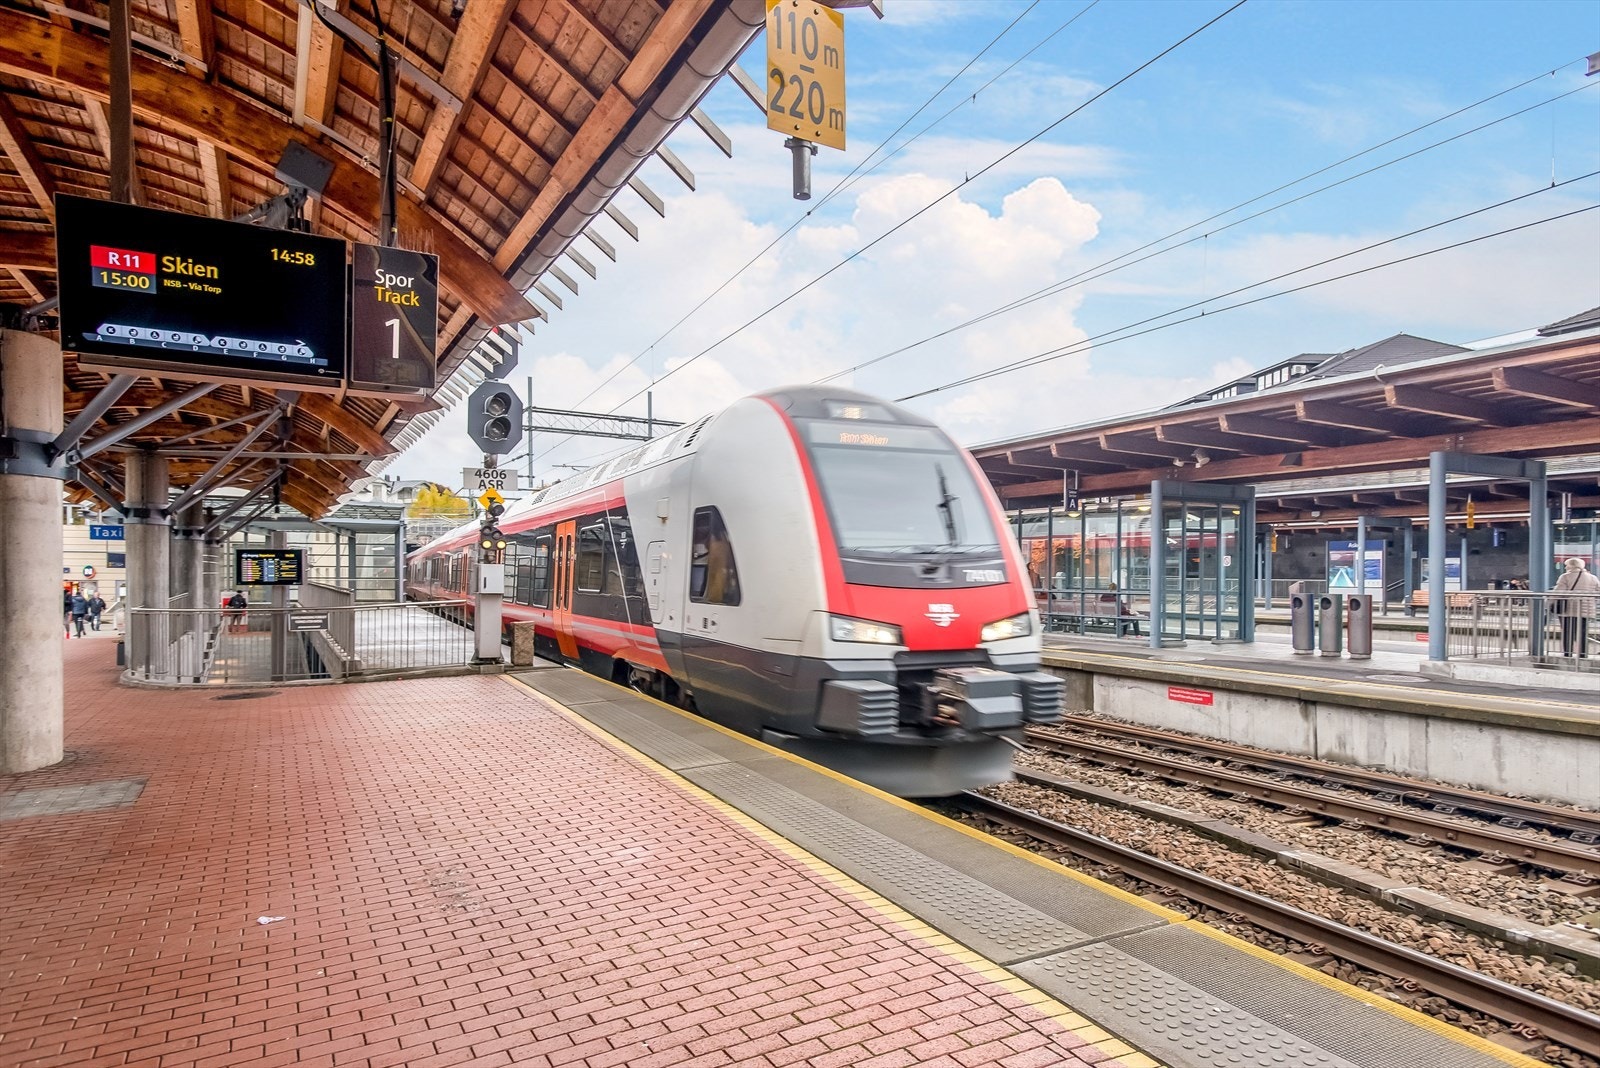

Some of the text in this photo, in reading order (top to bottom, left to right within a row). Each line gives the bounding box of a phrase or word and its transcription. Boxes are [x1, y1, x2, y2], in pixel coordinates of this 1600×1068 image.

[774, 6, 839, 69] 110 m
[770, 68, 843, 132] 220 m
[108, 252, 140, 268] R 11
[271, 248, 315, 266] 14:58
[162, 256, 218, 279] Skien
[100, 271, 150, 289] 15:00
[163, 279, 182, 288] NSB
[189, 283, 202, 291] Via
[203, 284, 222, 294] Torp
[375, 268, 414, 288] Spor
[374, 286, 420, 307] Track
[385, 318, 400, 359] 1
[474, 469, 507, 479] 4606
[478, 480, 504, 490] ASR
[1069, 498, 1076, 508] A
[93, 527, 122, 537] Taxi
